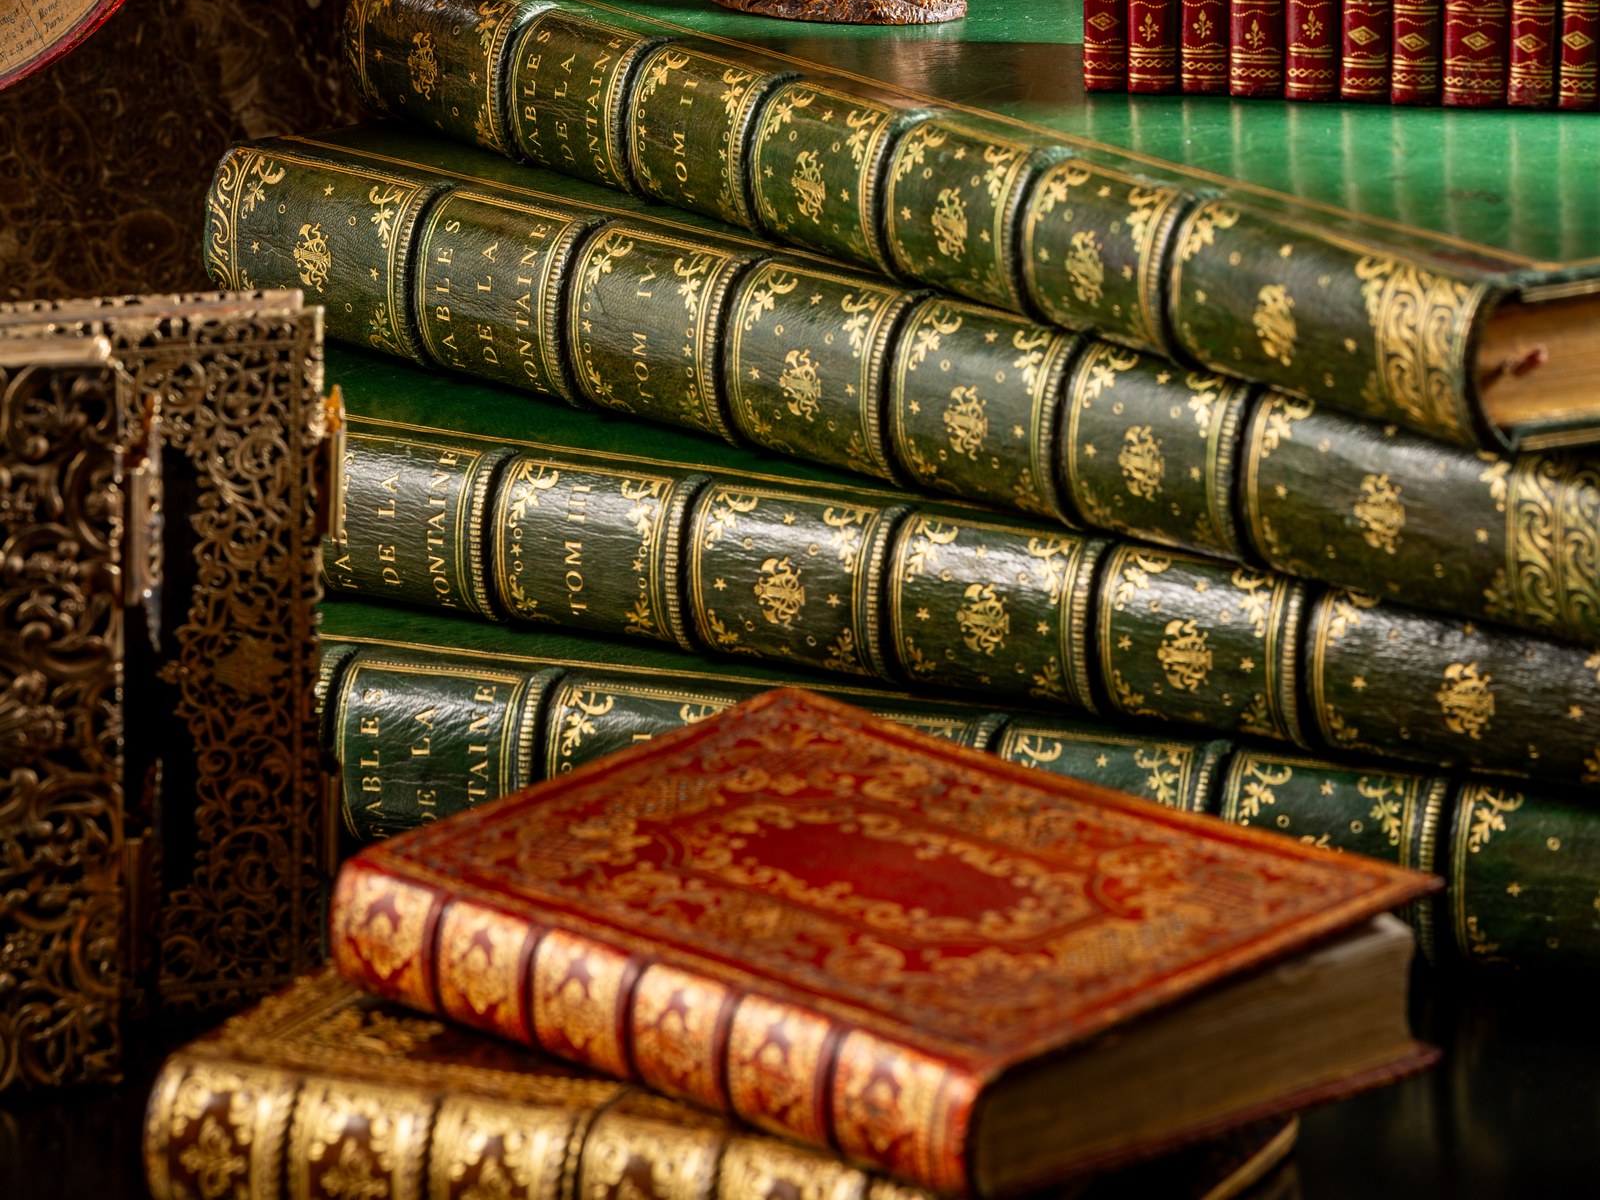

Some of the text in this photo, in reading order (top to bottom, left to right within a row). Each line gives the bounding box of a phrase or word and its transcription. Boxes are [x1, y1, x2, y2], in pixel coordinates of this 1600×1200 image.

[523, 30, 551, 166] FABLES
[554, 53, 577, 165] DE LA
[586, 38, 627, 187] FONTAINE
[679, 78, 699, 108] II
[436, 220, 466, 369] FABLES
[477, 242, 500, 365] DE LA
[516, 223, 551, 393] FONTAINE
[631, 263, 657, 405] TOM IV
[377, 472, 402, 586] DE LA
[427, 451, 458, 608] FONTAINE
[564, 484, 592, 616] TOM III
[360, 690, 391, 839] FABLES
[411, 705, 436, 758] LA
